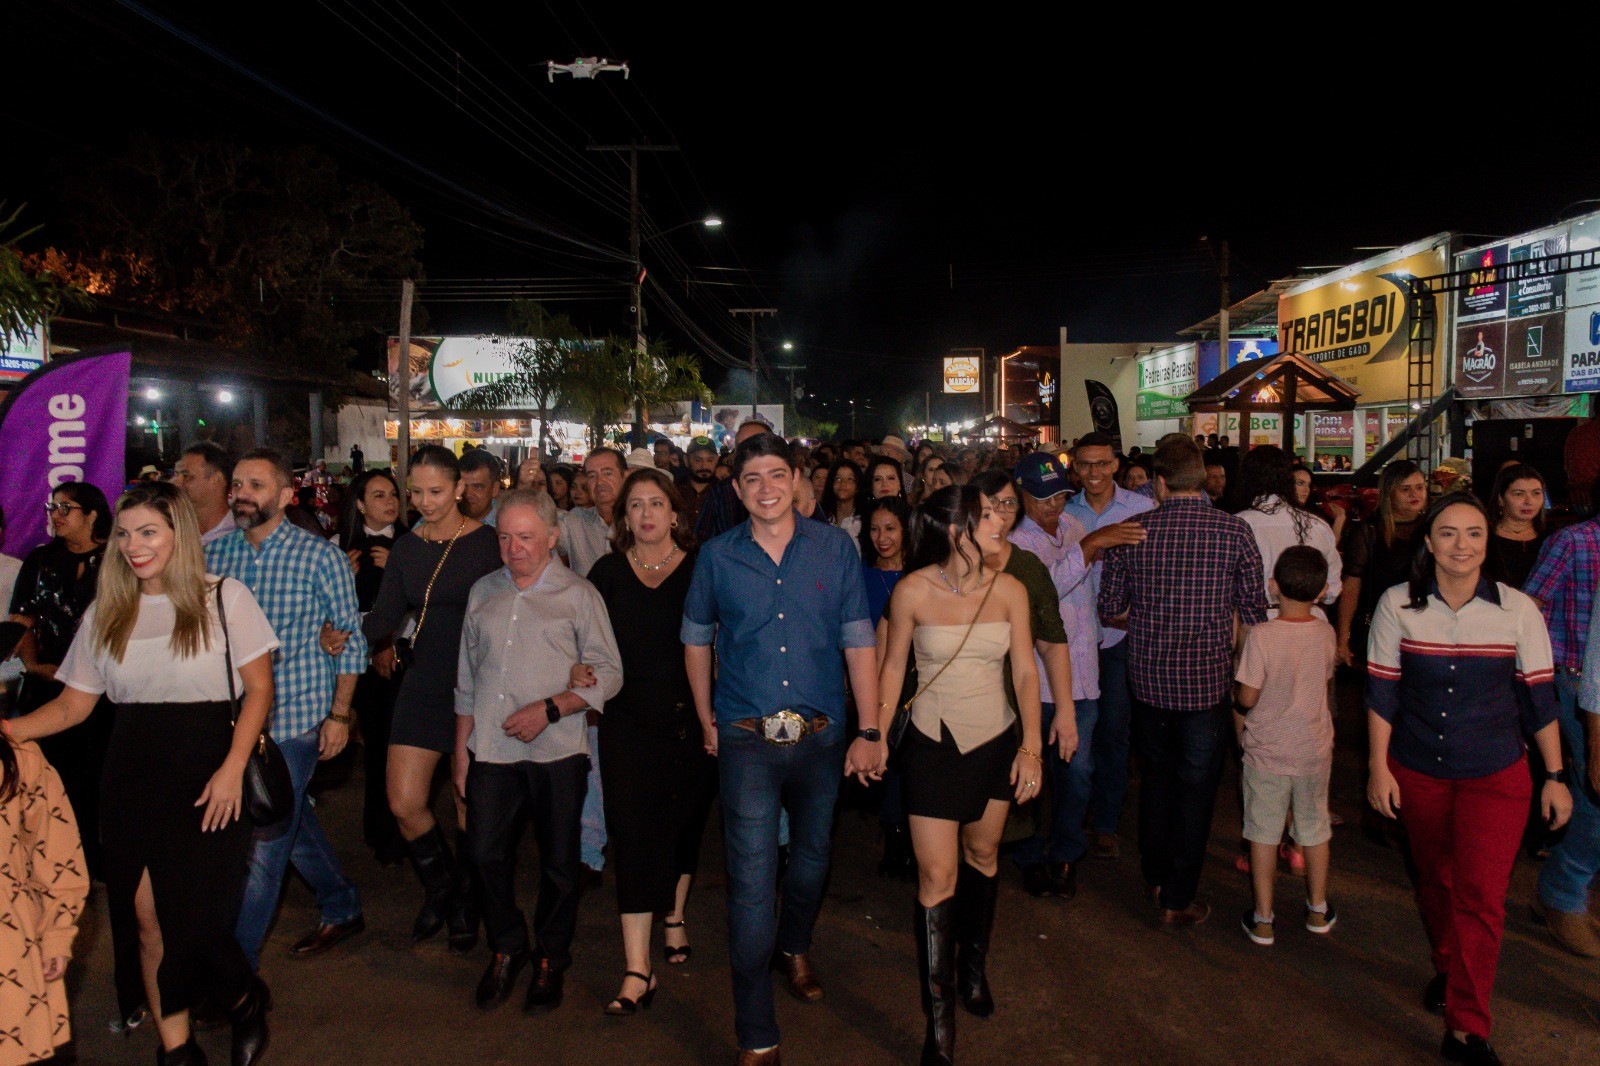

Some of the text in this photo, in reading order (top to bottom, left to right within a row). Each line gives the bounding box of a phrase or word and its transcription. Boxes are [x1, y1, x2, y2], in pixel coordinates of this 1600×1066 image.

[1282, 292, 1396, 353] TRANSBOI
[1308, 344, 1368, 362] NSPORTE DE GADO
[1463, 353, 1496, 372] MAGRÃO
[1509, 359, 1559, 370] ISABELA ANDRADE
[1145, 365, 1171, 384] Pedreiras
[1571, 369, 1586, 377] DAS
[1314, 427, 1336, 435] RIOS
[48, 394, 86, 505] ome
